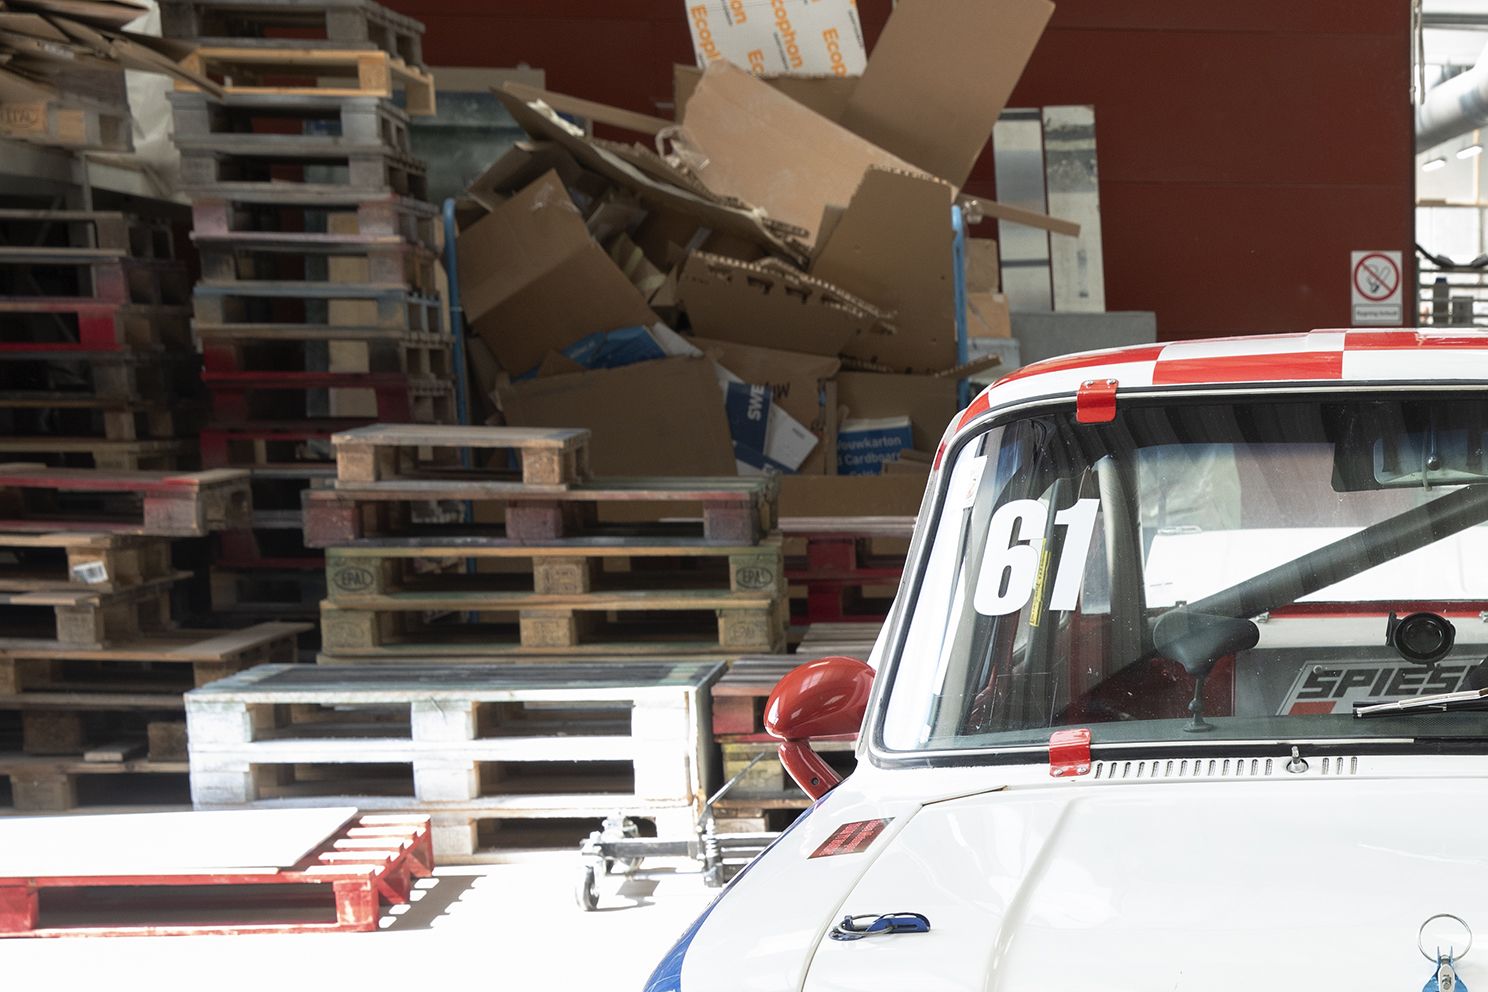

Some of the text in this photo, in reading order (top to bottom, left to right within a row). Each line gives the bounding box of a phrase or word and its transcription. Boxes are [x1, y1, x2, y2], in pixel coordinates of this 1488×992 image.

[771, 0, 803, 68] cophon
[822, 27, 848, 79] Ecop
[747, 384, 765, 421] SWE
[974, 498, 1100, 616] 61
